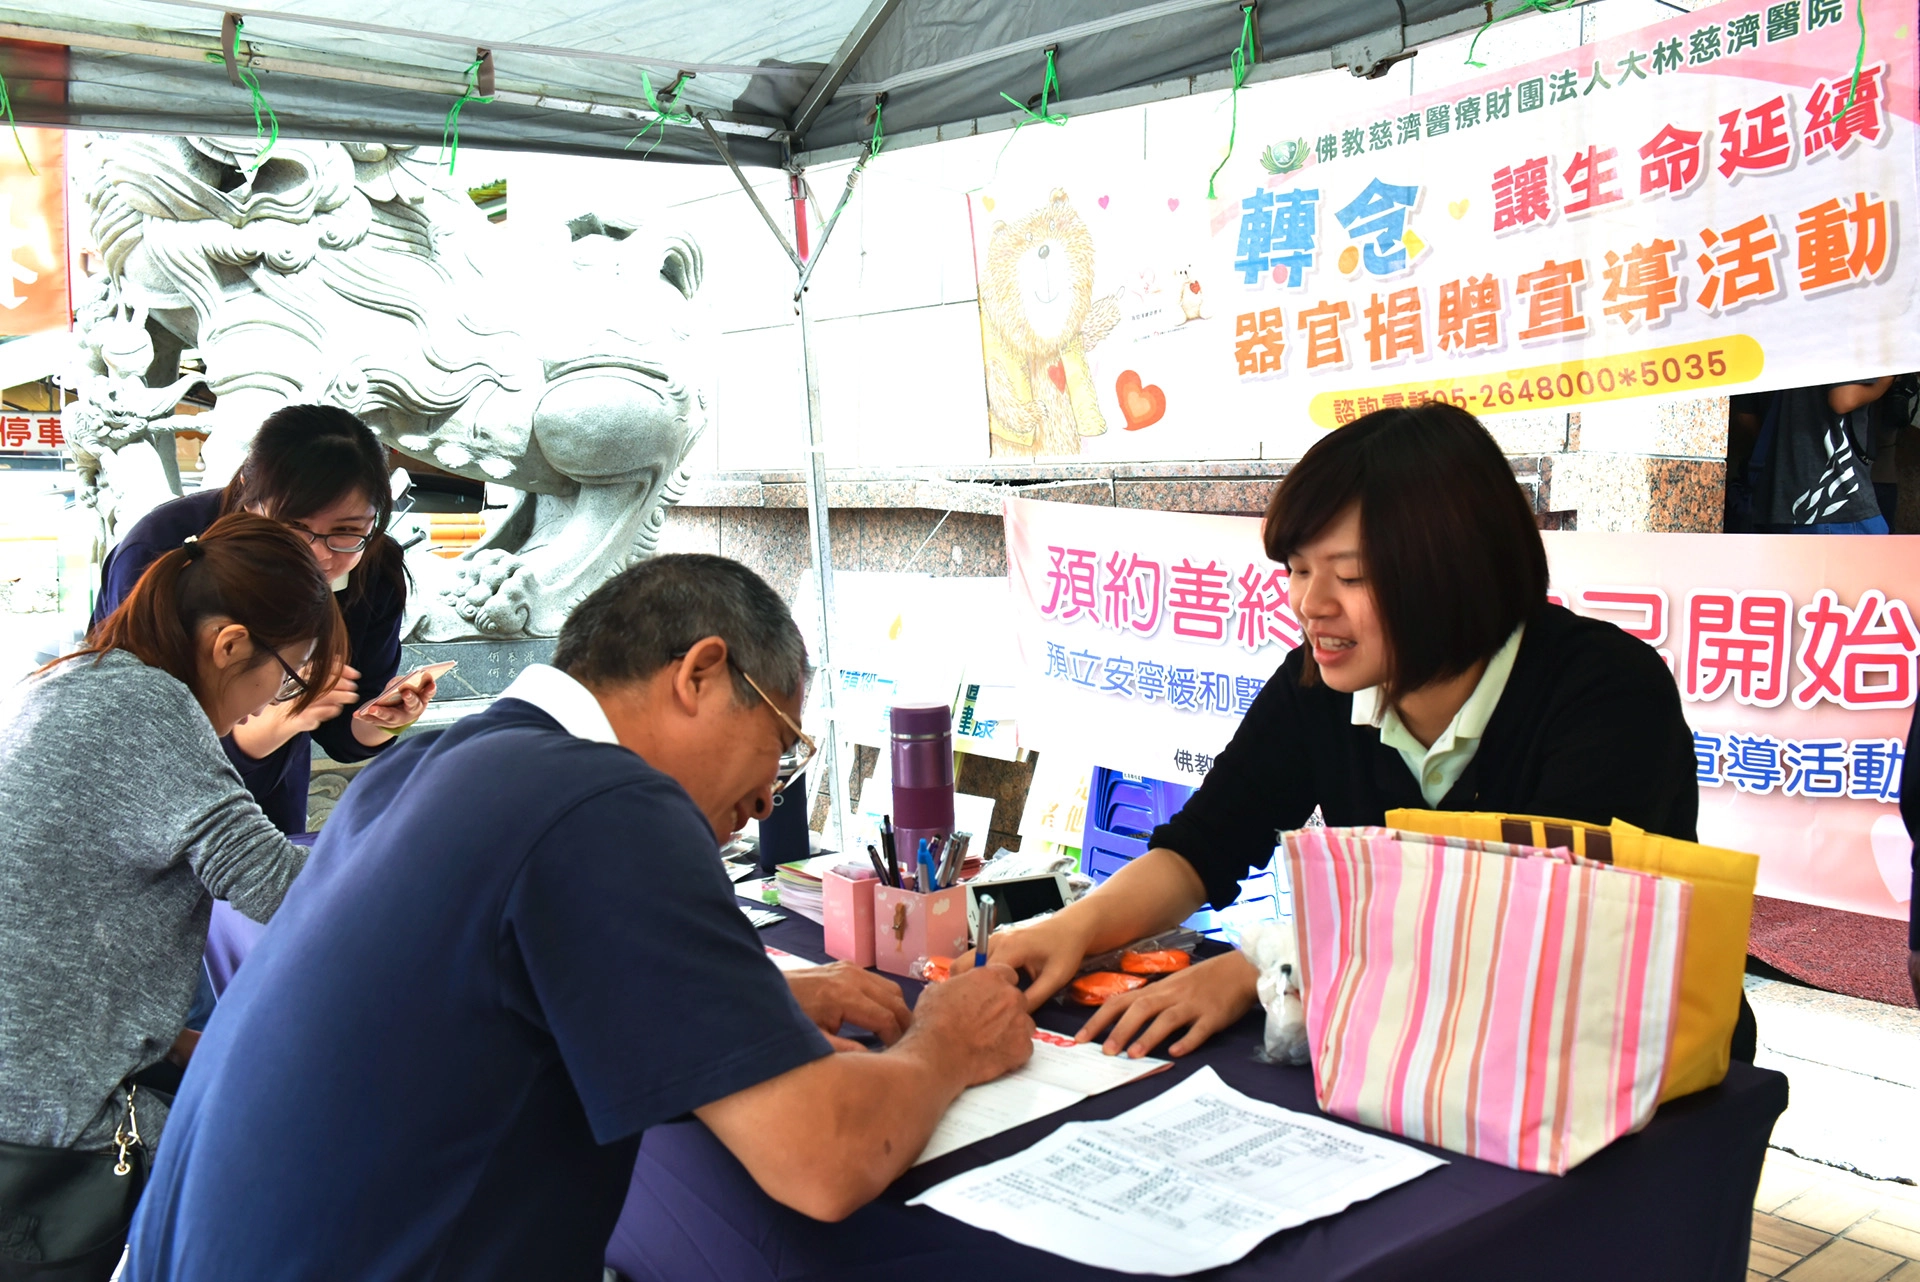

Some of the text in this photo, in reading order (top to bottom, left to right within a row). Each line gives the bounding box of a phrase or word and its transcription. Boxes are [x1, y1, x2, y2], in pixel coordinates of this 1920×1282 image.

[1315, 0, 1843, 165] 佛教慈濟醫療財團法人大林慈濟醫院
[1234, 64, 1889, 288] 轉念 讓生命延續
[1234, 192, 1888, 376] 器官捐贈宣導活動
[0, 416, 65, 448] 停車
[1041, 546, 1301, 648] 預約善終
[1173, 748, 1214, 776] 佛教
[1693, 731, 1907, 799] 宣導活動
